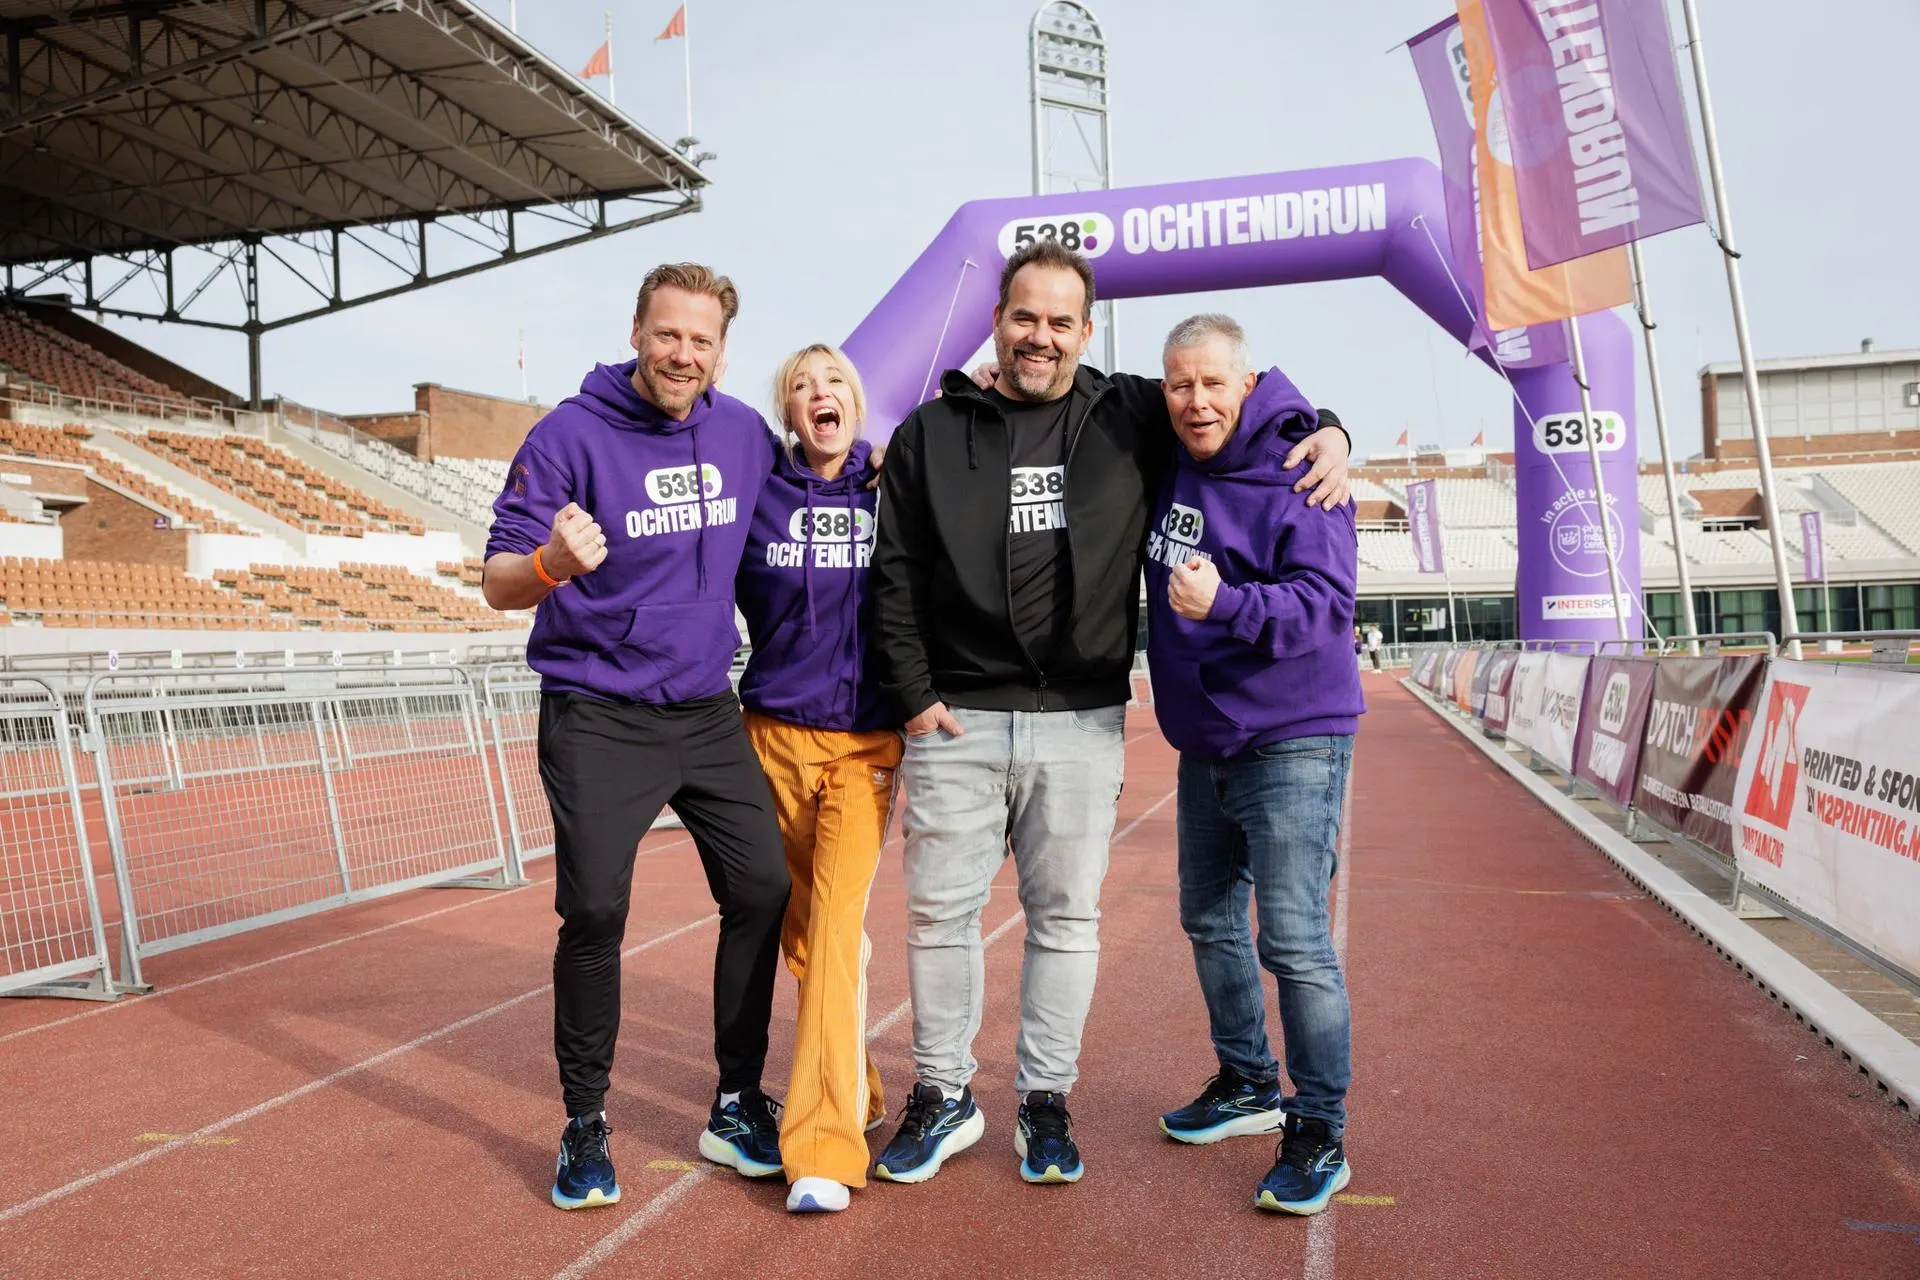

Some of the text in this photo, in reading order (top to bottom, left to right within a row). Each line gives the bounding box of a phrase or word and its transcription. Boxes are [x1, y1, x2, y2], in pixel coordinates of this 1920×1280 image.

[1123, 183, 1387, 254] OCHTENDRUN
[656, 471, 701, 498] 538
[1011, 472, 1063, 497] 538
[626, 497, 737, 538] OCHTENDRUN
[801, 513, 849, 536] 538
[1804, 747, 1862, 791] PRINTED
[1864, 764, 1876, 796] &
[1816, 790, 1920, 864] M2PRINTING.N
